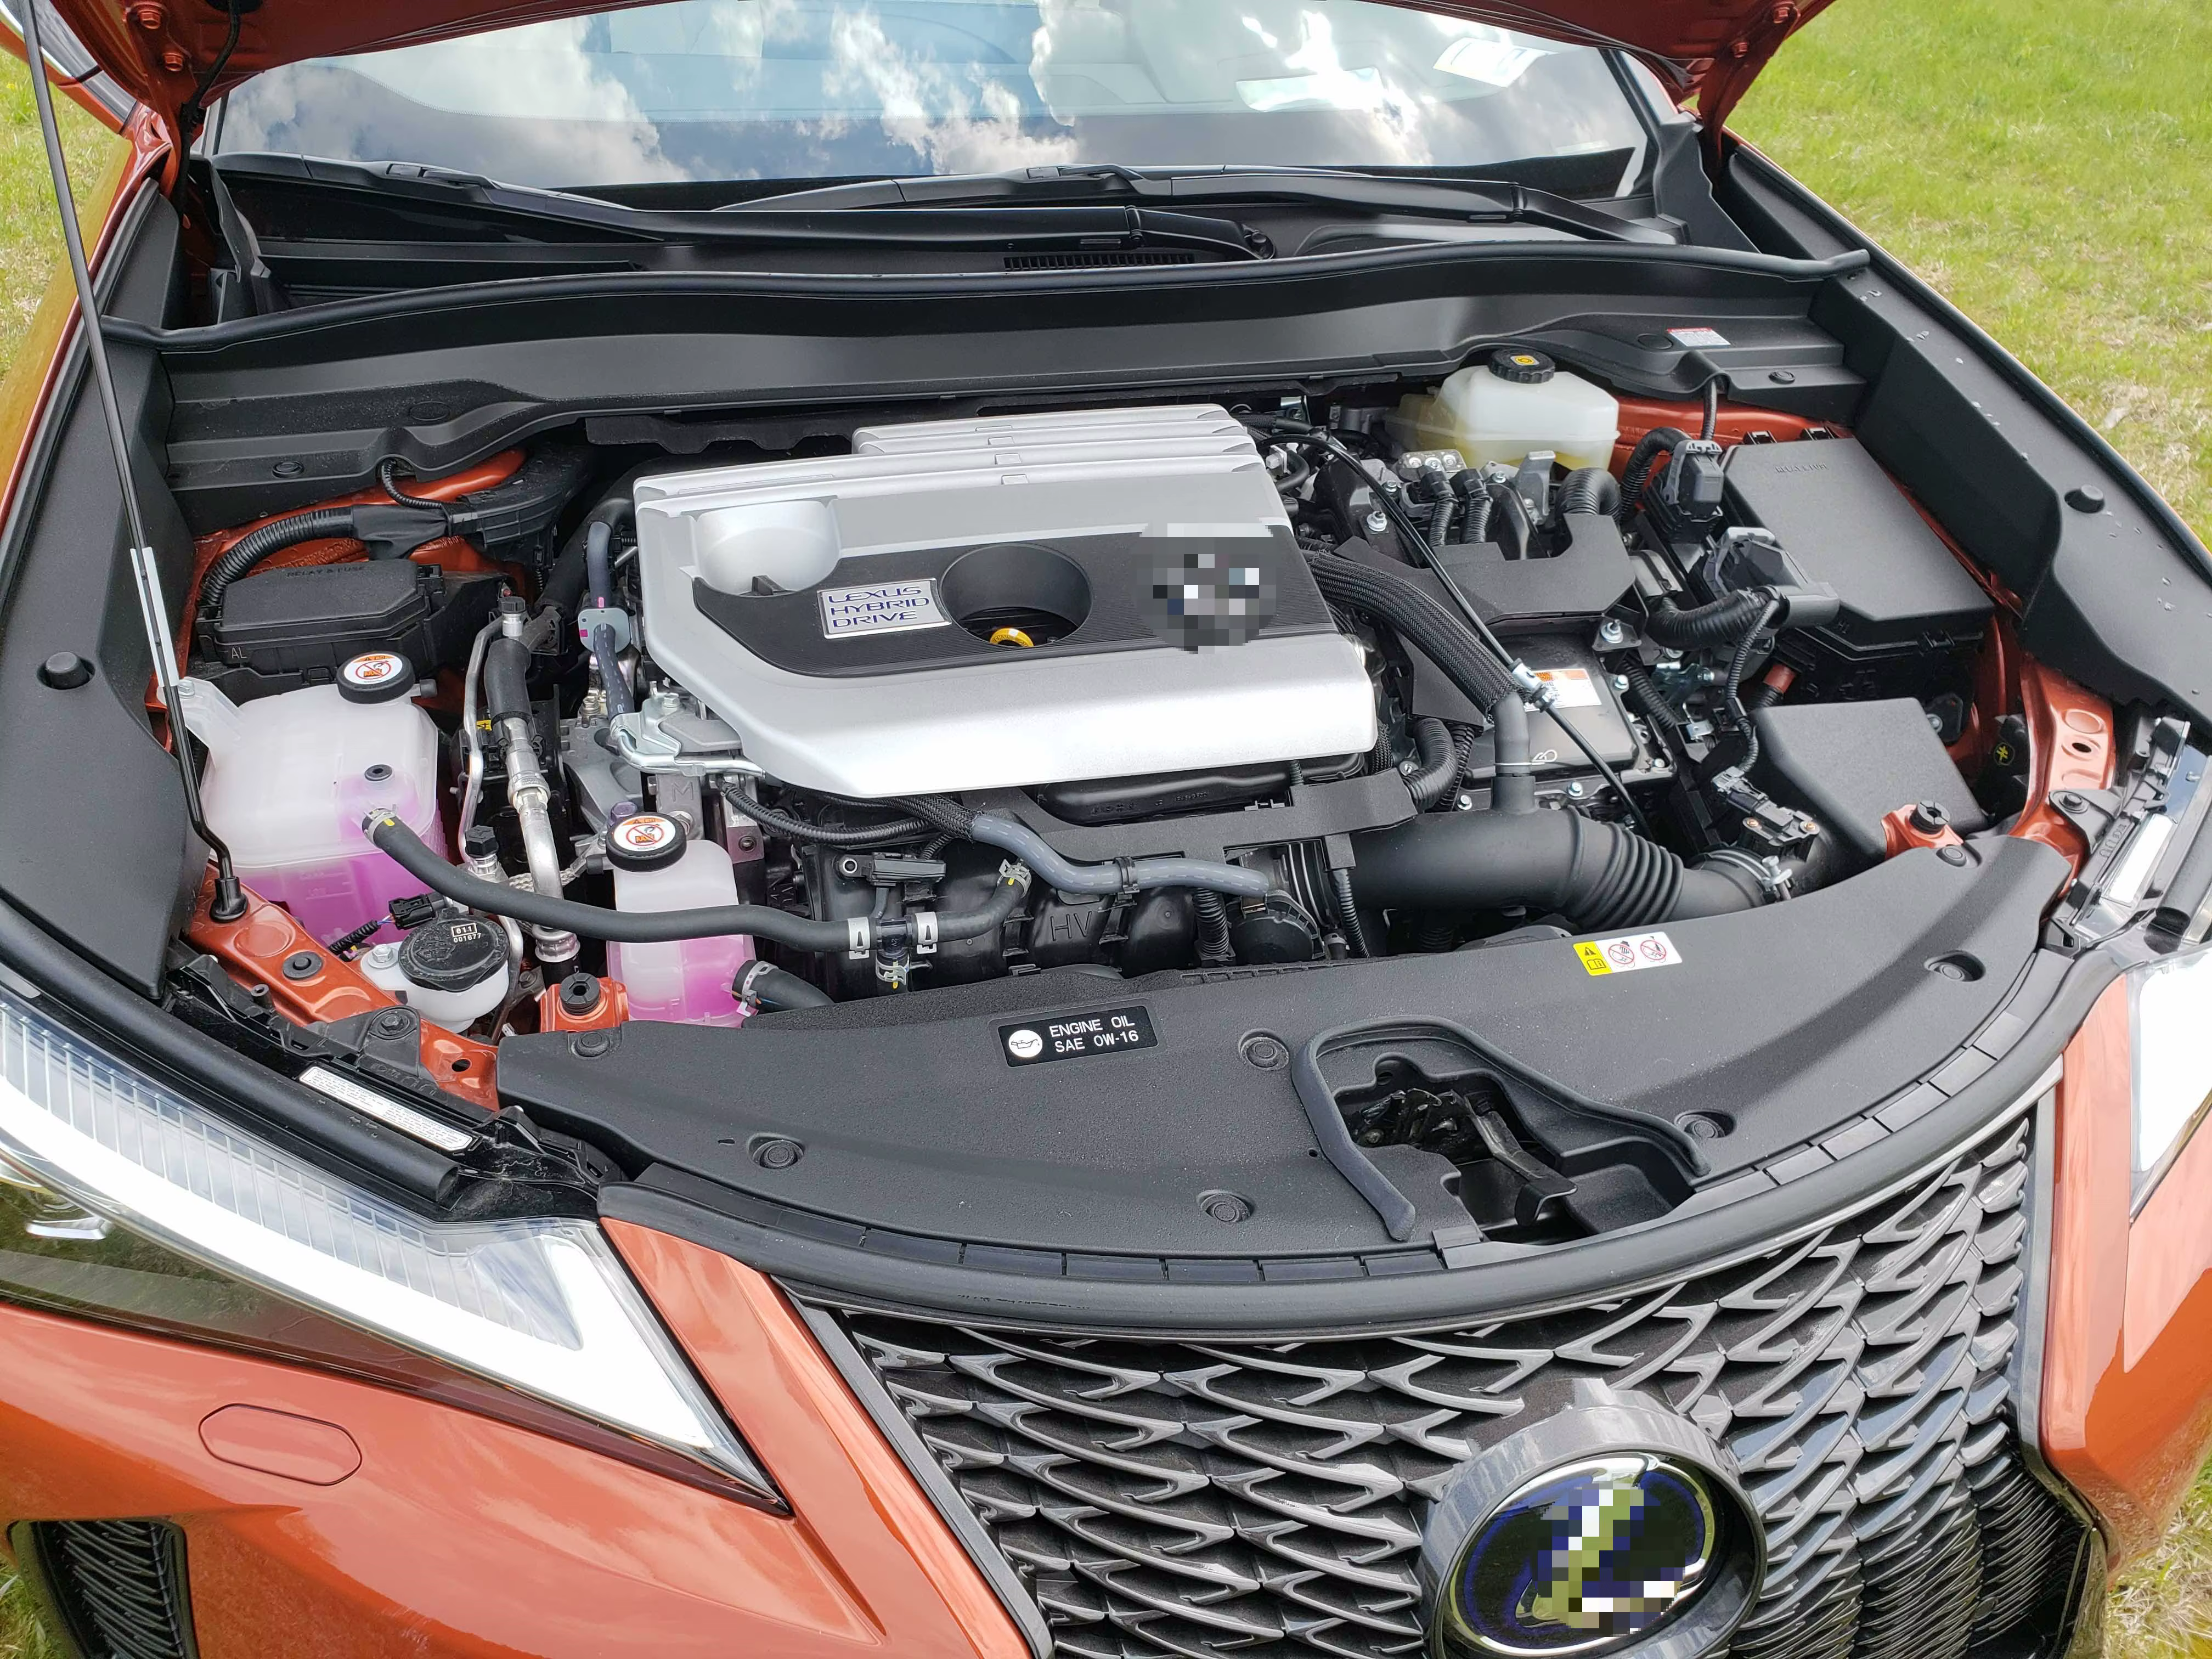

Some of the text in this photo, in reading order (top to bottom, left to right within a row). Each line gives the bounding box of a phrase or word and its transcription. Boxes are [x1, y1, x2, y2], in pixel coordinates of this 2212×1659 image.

[828, 586, 922, 603] LEXUS
[831, 597, 930, 616] HYBRID
[833, 610, 917, 628] DRIVE
[232, 647, 247, 658] AL
[1050, 911, 1092, 941] HV
[1049, 1015, 1135, 1037] ENGINE OIL
[1054, 1030, 1139, 1053] SAE 0W-16
